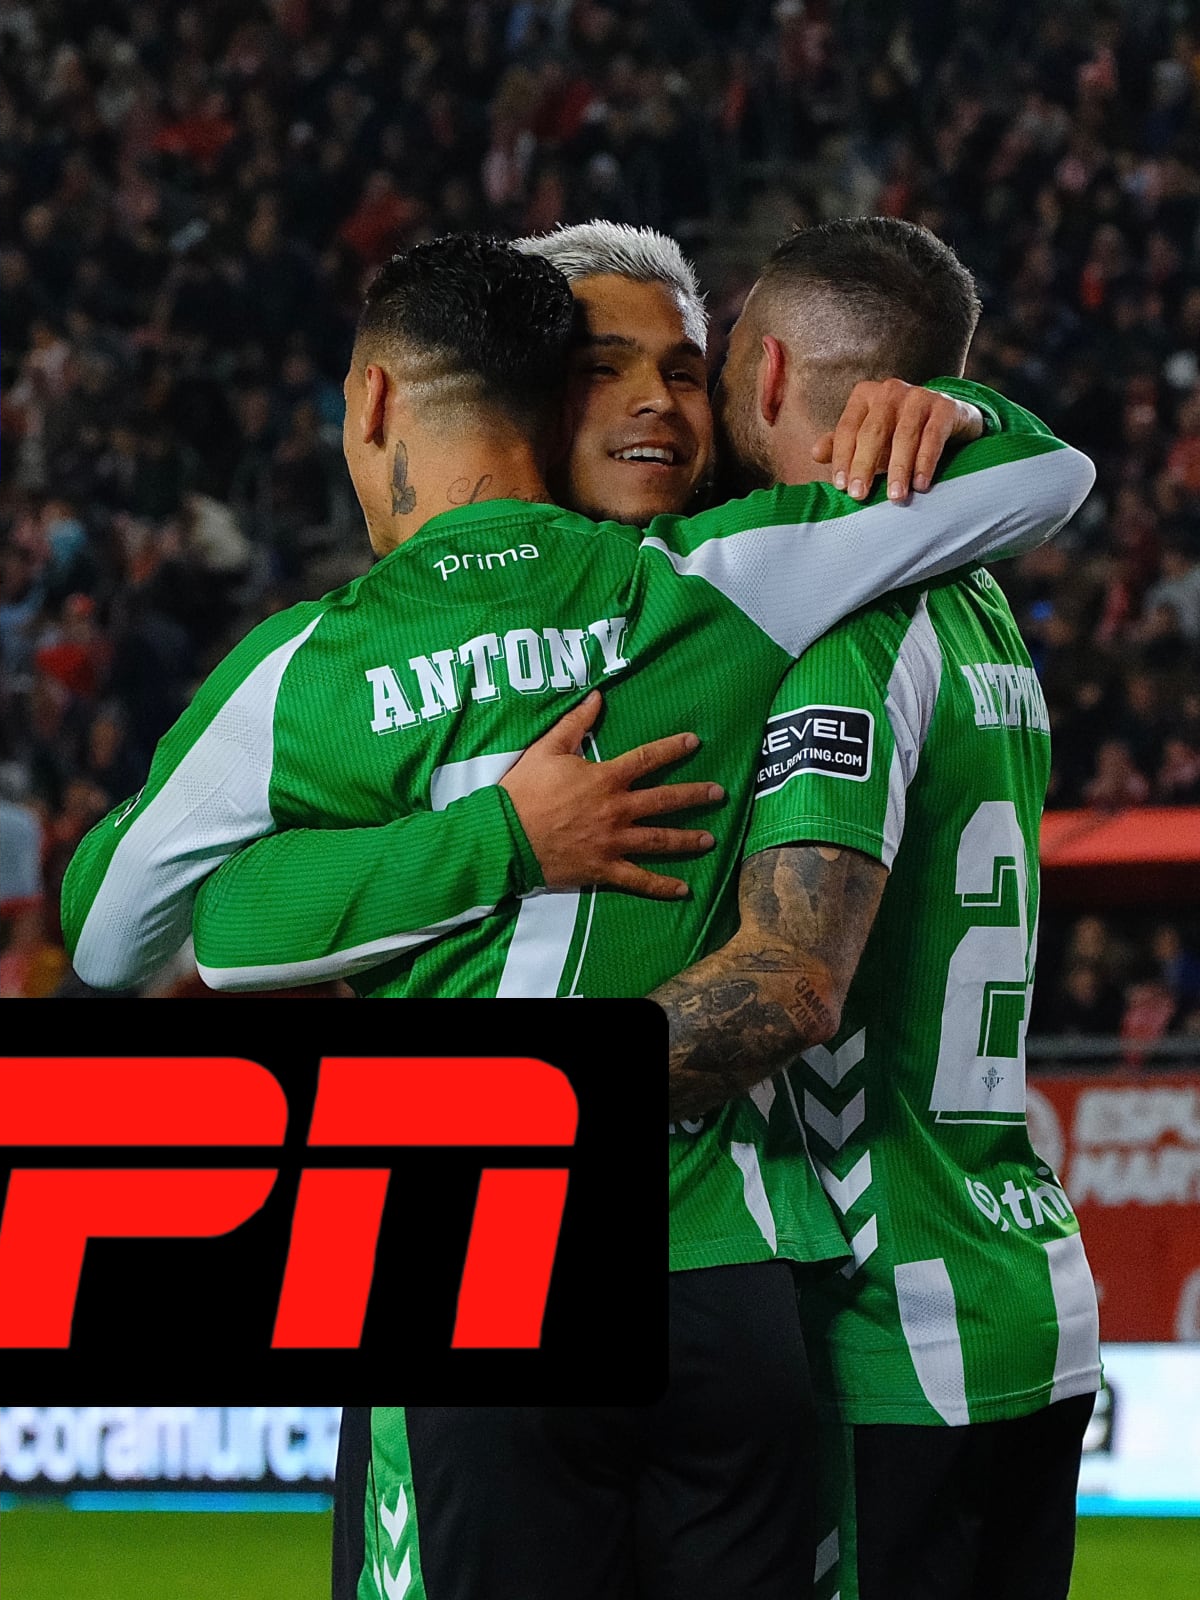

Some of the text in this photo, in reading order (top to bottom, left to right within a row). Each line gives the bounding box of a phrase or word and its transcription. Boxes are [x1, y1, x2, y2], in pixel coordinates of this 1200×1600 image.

[432, 543, 540, 582] prima
[364, 616, 631, 736] ANTONY
[756, 746, 863, 784] EVELRENTING.COM
